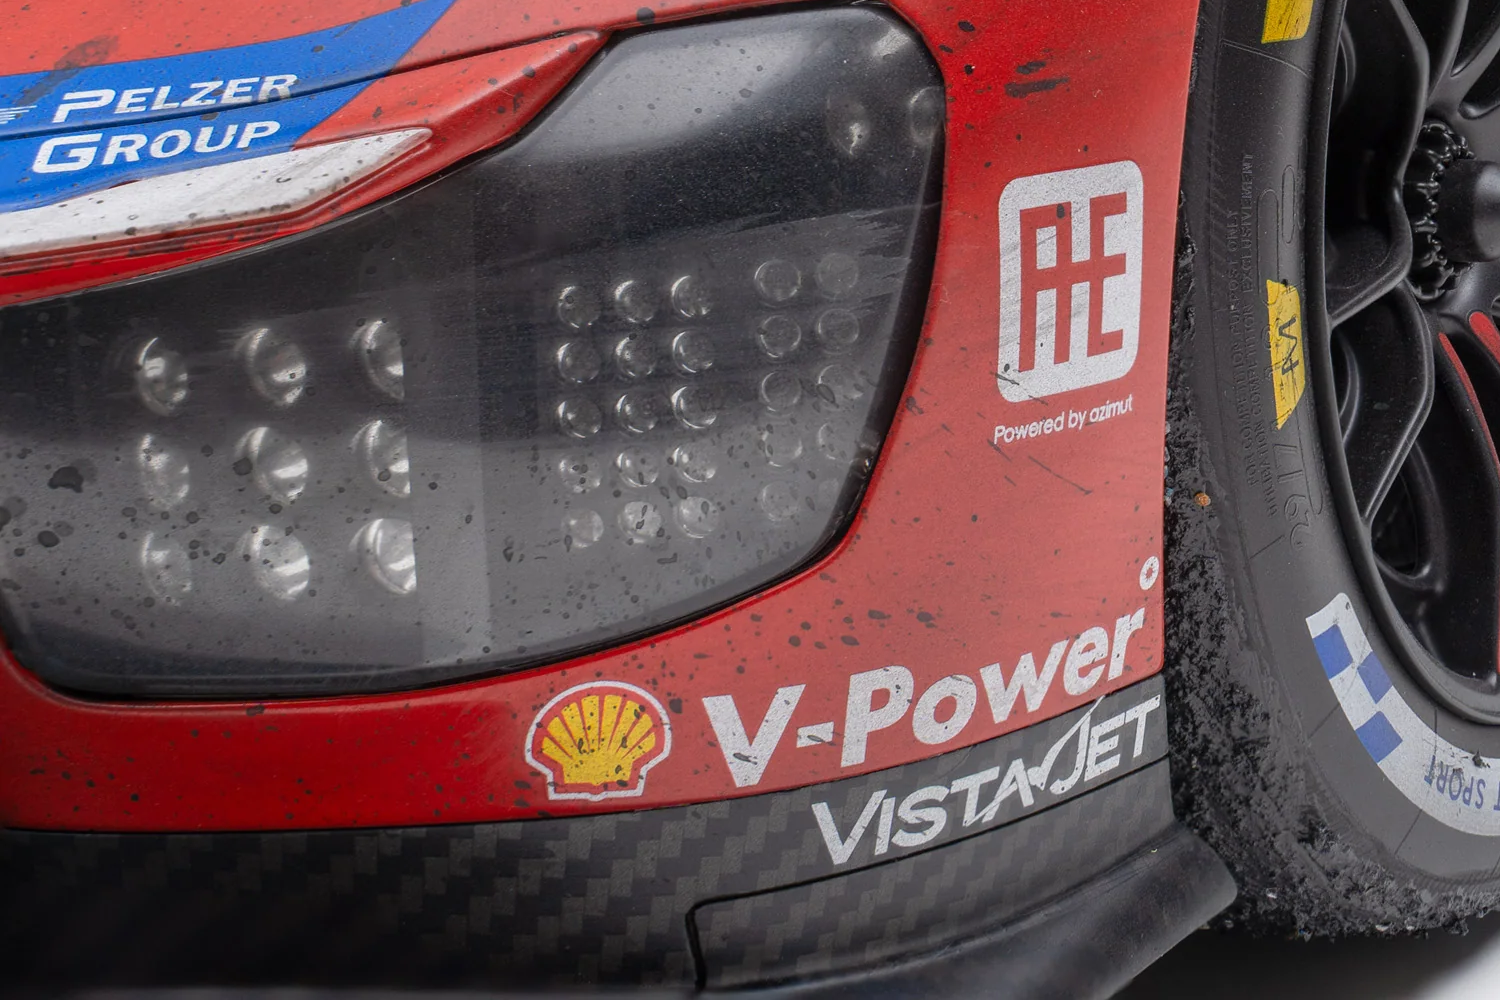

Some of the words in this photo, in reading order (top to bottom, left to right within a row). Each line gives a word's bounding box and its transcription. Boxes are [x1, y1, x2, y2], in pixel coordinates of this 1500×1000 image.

[53, 73, 298, 124] PELZER
[32, 120, 281, 174] GROUP
[994, 411, 1064, 445] Powered
[1069, 407, 1087, 430] by
[1089, 394, 1133, 423] azimut
[702, 607, 1145, 788] V-Power
[812, 695, 1161, 866] VISTAJET
[1424, 754, 1485, 811] SPORT
